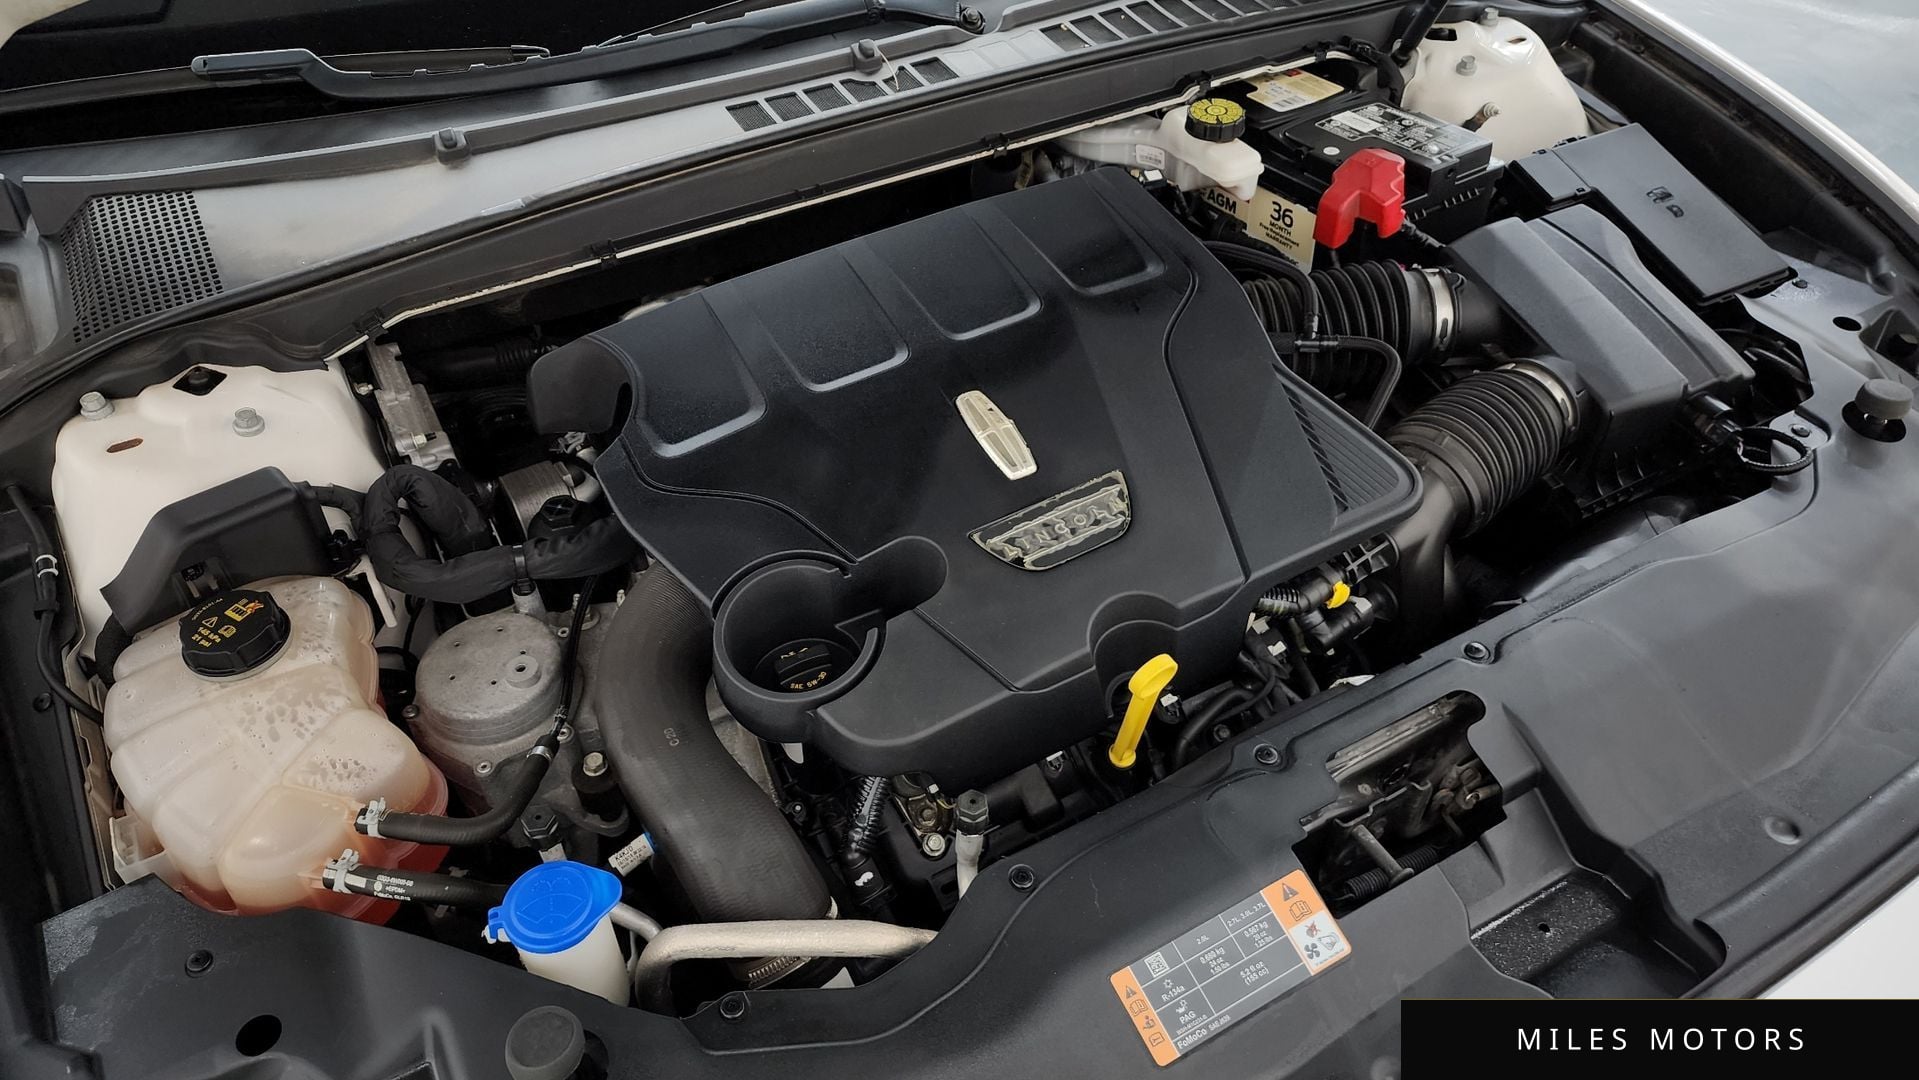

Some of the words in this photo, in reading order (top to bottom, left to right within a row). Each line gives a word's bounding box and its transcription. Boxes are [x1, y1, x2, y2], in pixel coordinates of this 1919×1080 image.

[1207, 189, 1237, 214] AGM
[1270, 201, 1294, 228] 36
[1260, 222, 1269, 232] Free
[1269, 221, 1291, 236] MONTH
[1266, 232, 1292, 250] WARRANTY
[1259, 922, 1268, 930] kg
[1215, 946, 1226, 955] kg
[1244, 974, 1259, 986] (155
[1161, 985, 1186, 1002] R-134a
[1179, 1010, 1196, 1024] PAG
[1177, 1028, 1208, 1050] FoMoCo
